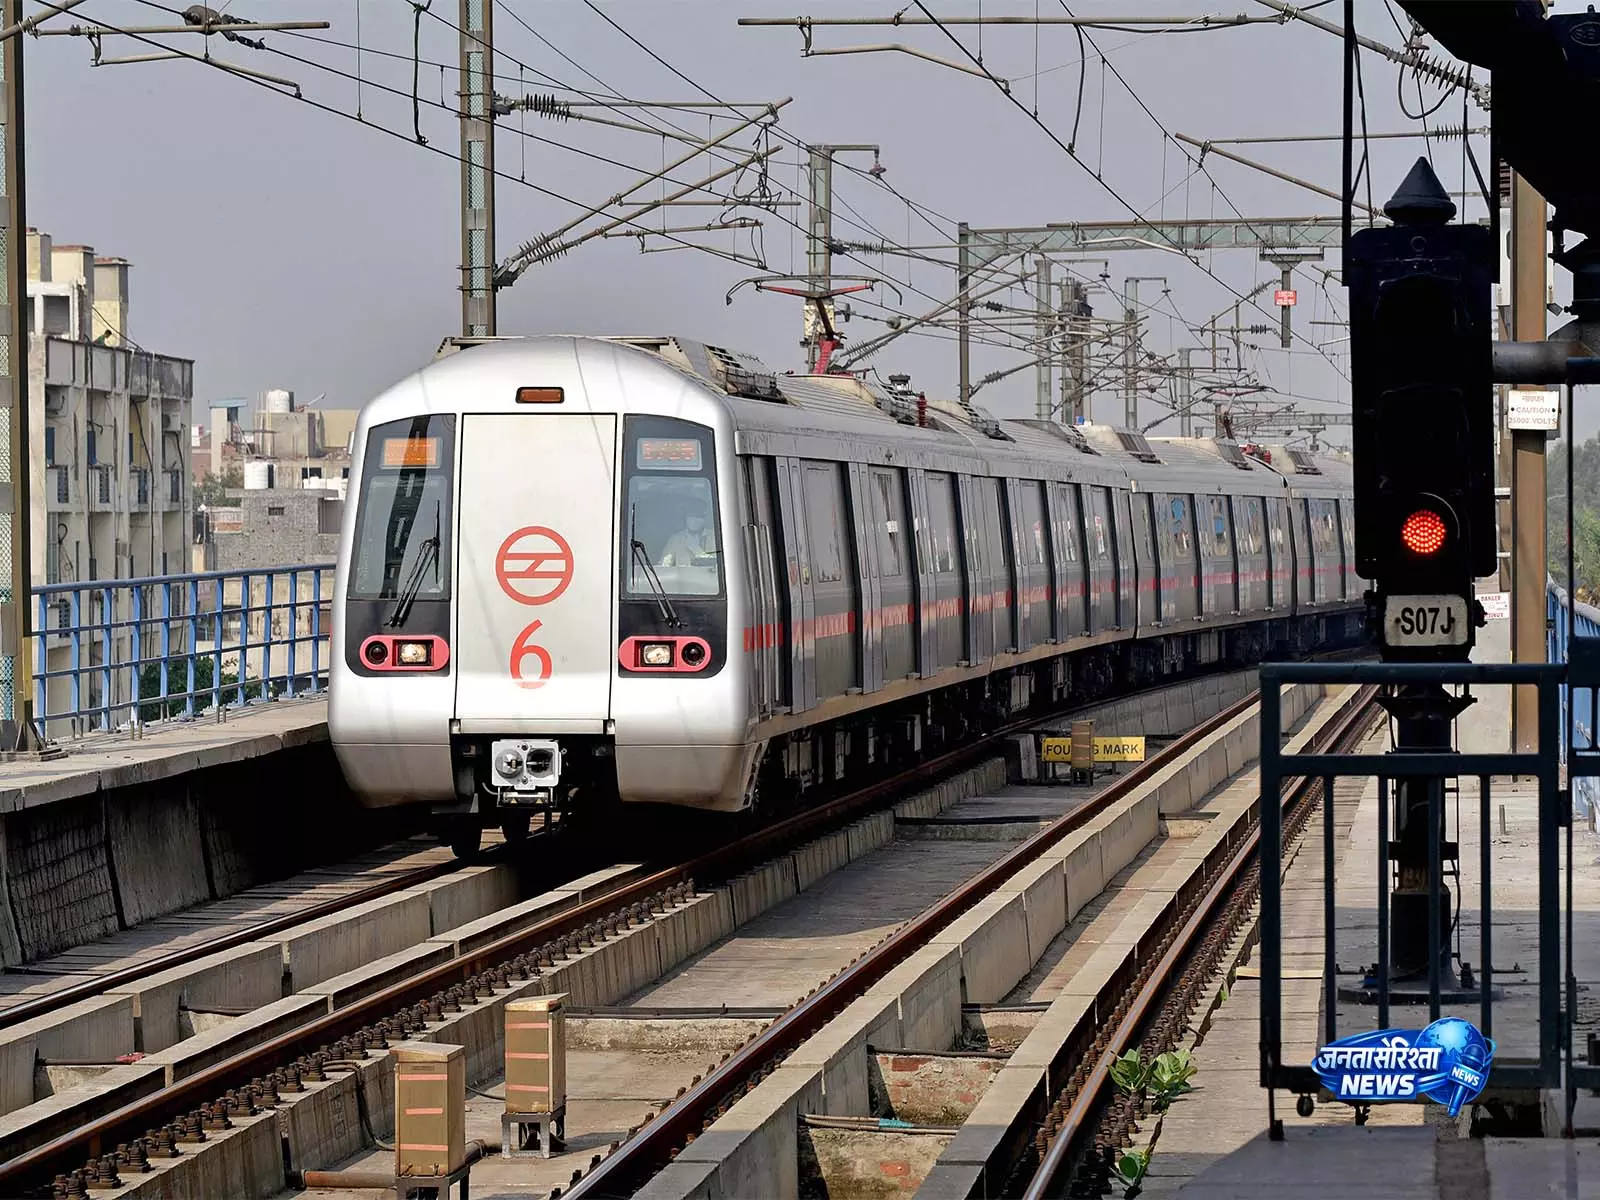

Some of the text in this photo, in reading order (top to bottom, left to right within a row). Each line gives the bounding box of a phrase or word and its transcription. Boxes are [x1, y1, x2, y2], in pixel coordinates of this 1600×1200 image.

[1516, 406, 1551, 414] CAUTION
[1531, 417, 1558, 425] VOLTS
[510, 619, 553, 690] 6
[1046, 743, 1139, 756] FOUG MARK
